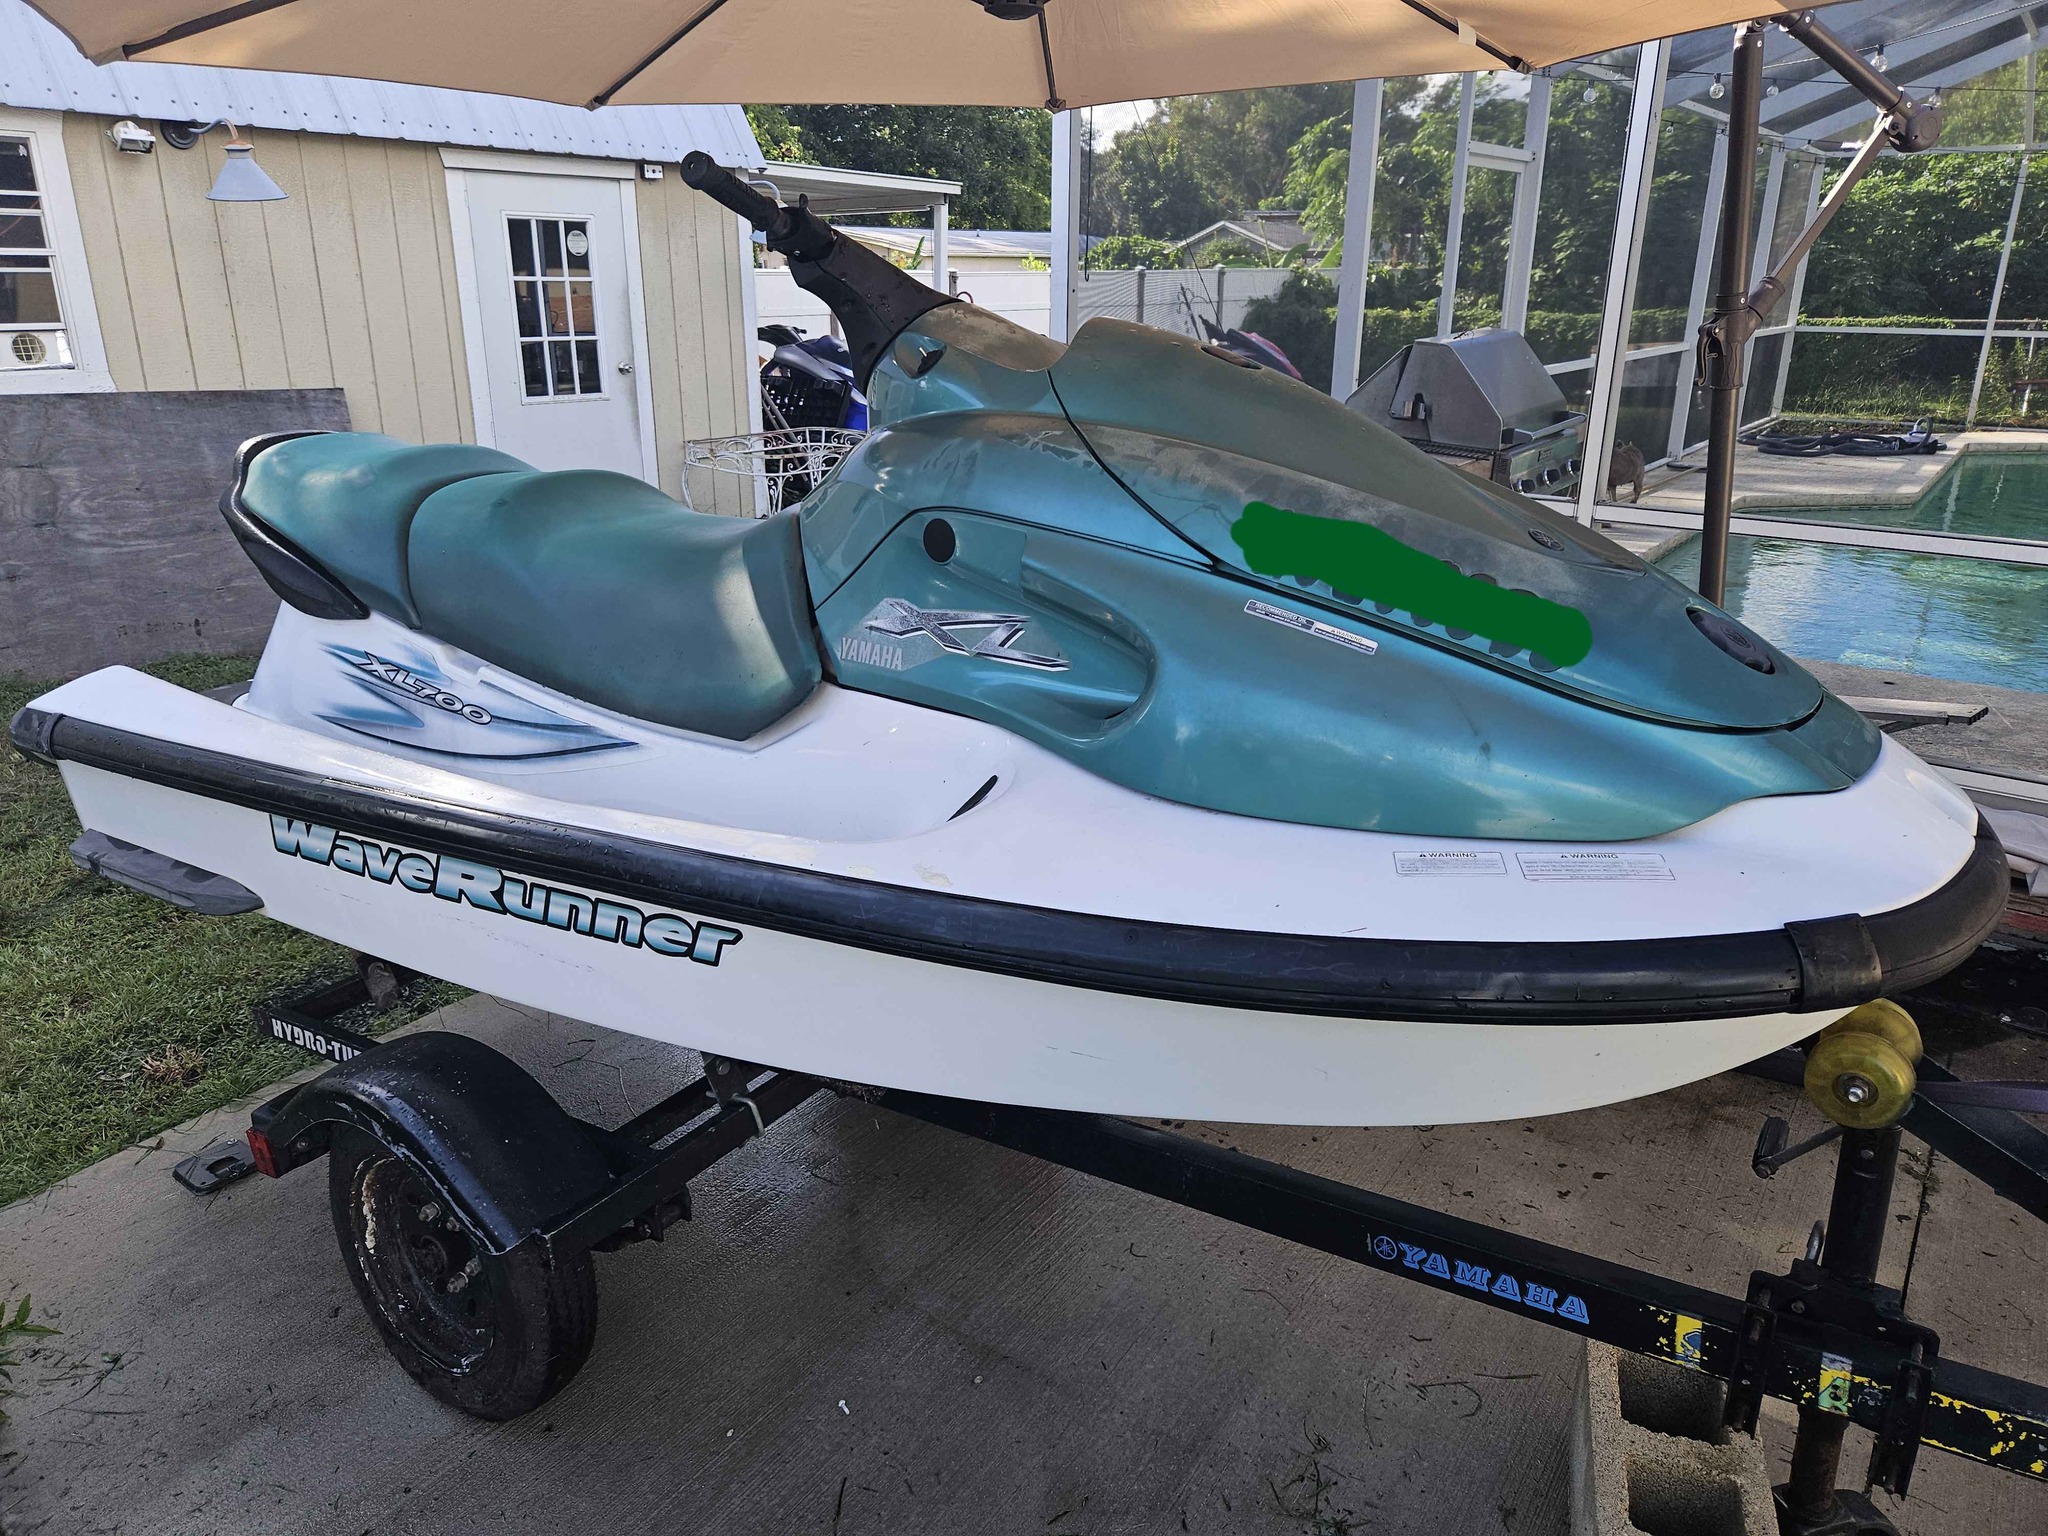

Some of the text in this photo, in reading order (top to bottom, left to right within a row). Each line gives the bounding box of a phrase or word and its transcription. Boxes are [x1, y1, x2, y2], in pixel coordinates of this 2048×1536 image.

[1254, 602, 1298, 620] RECOMMENDED
[1336, 630, 1363, 643] WARNING
[839, 637, 903, 669] YAMAHA
[356, 650, 493, 725] XL700
[269, 813, 744, 966] WaveRunner
[1398, 1241, 1590, 1325] YAMAHA
